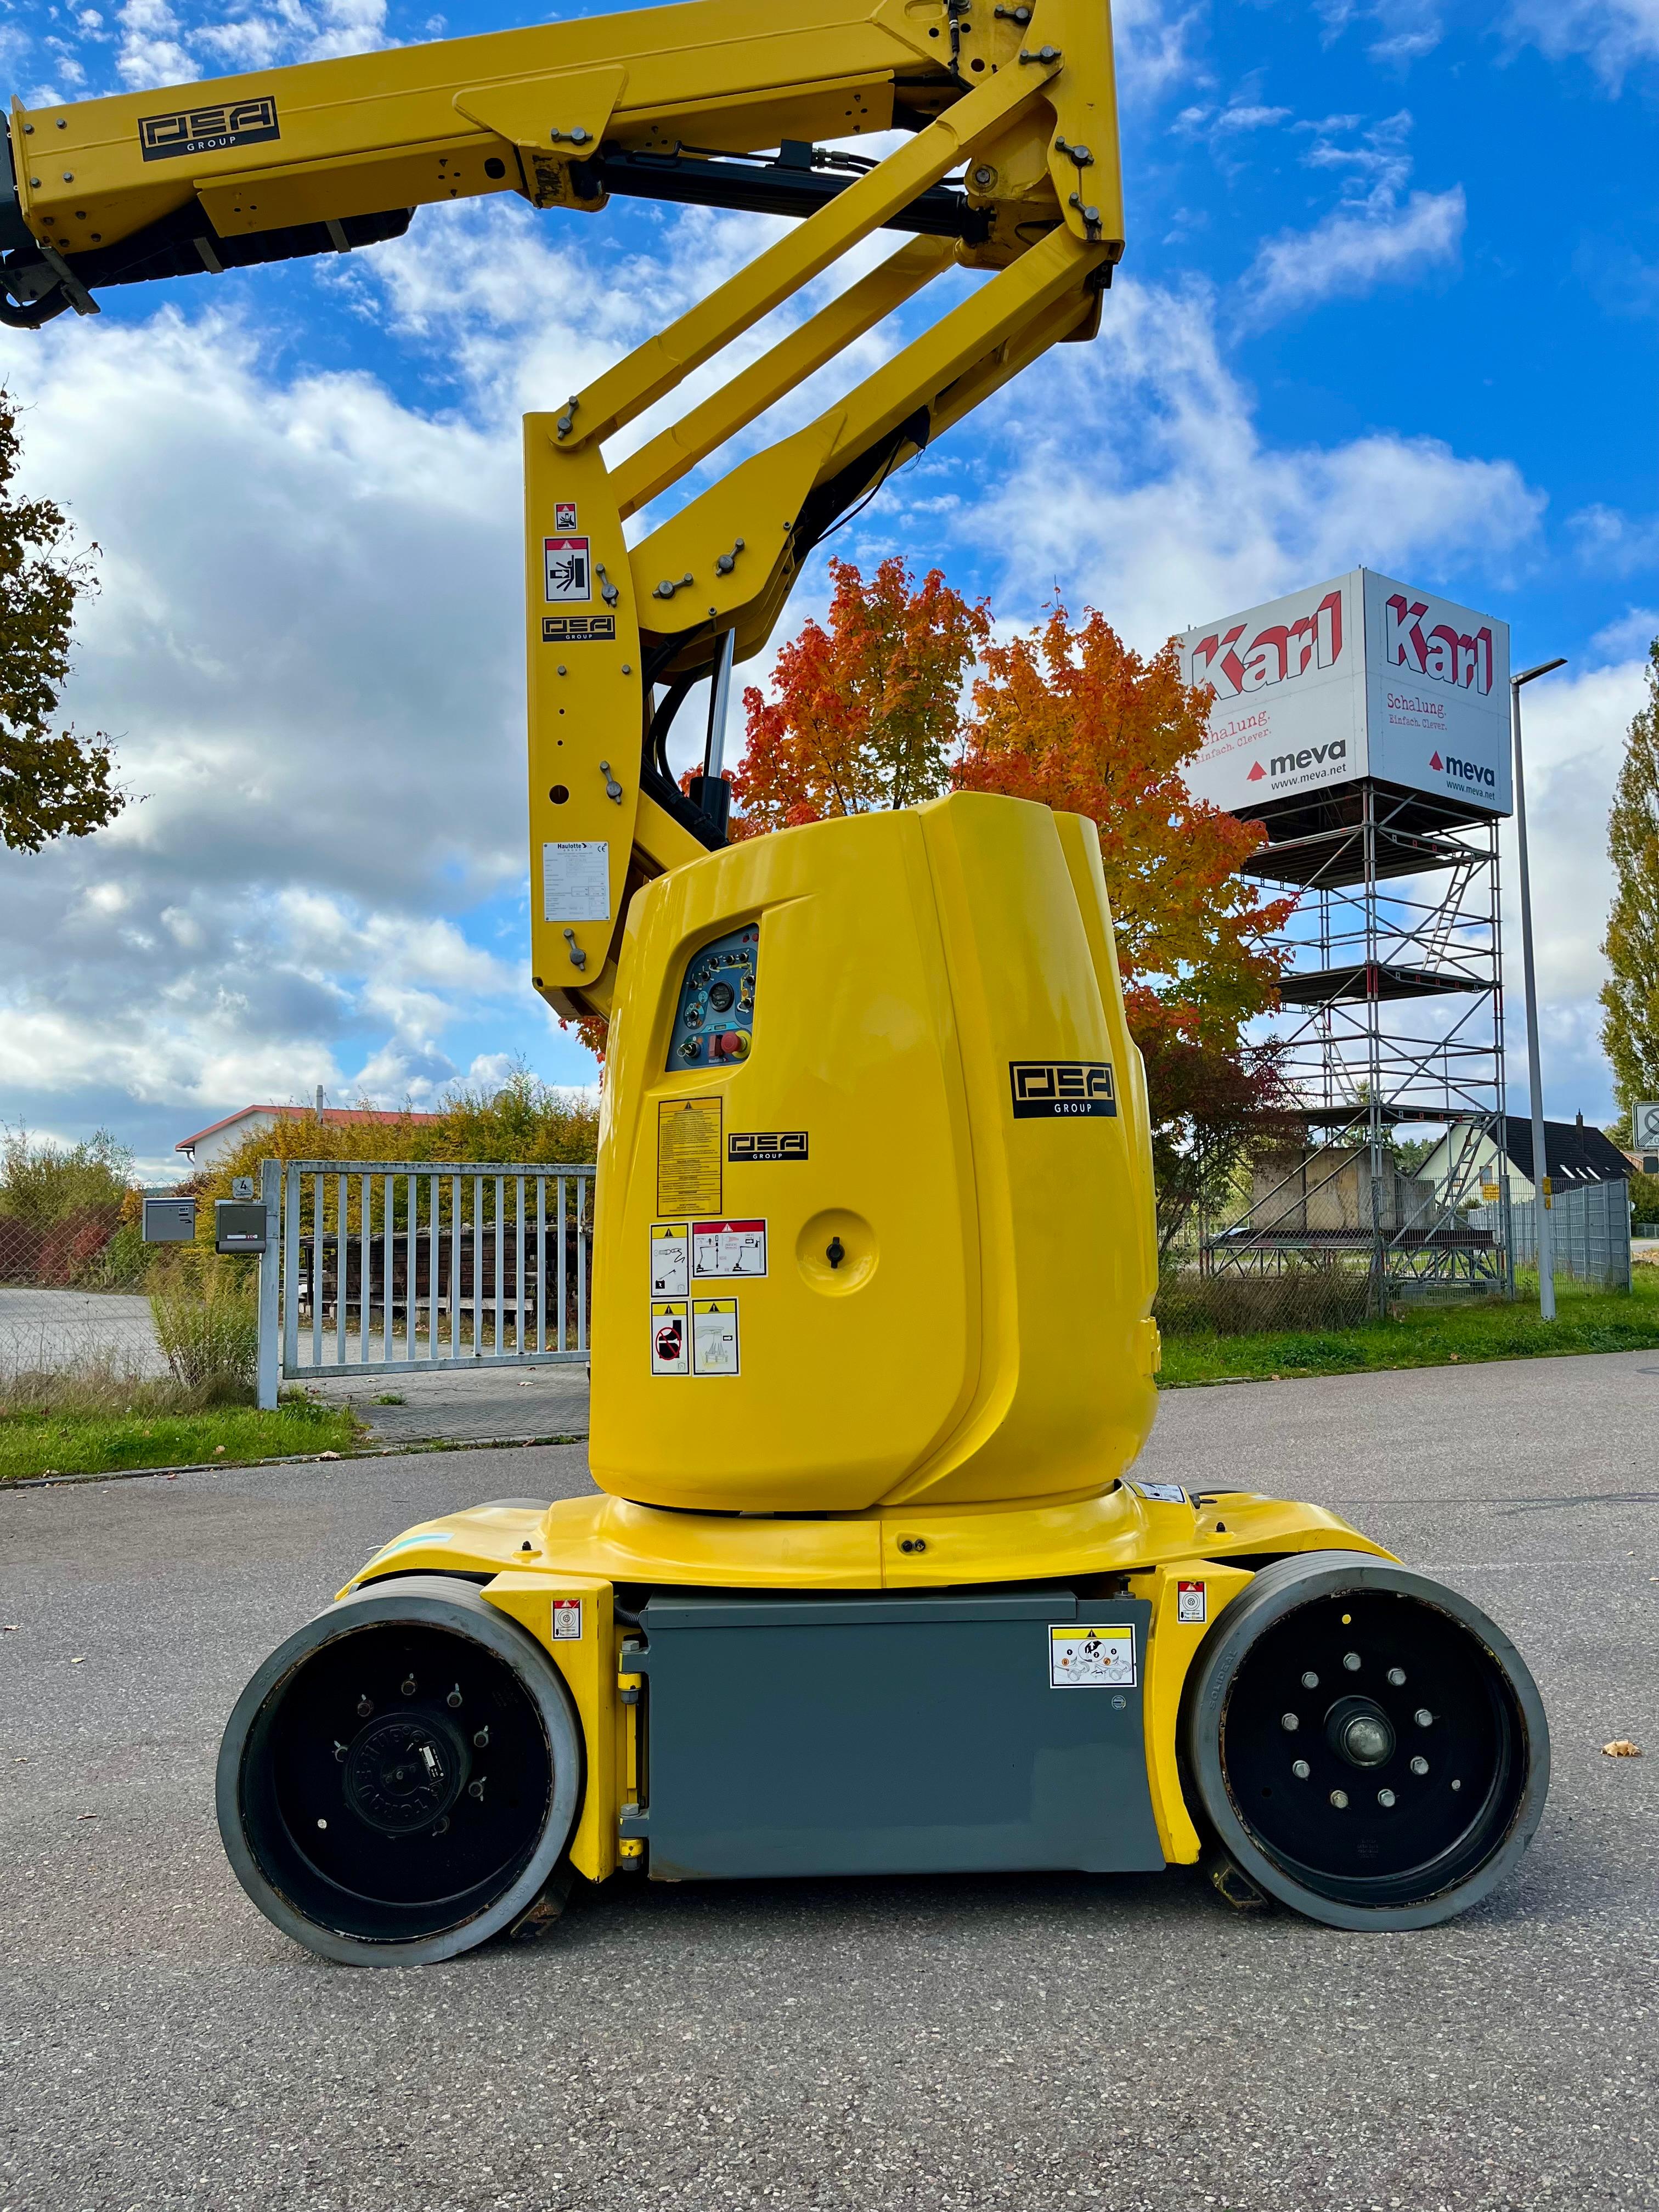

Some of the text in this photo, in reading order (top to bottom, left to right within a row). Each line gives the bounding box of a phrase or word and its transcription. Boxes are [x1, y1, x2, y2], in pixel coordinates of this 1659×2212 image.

[187, 136, 236, 151] GROUP
[1192, 590, 1342, 700] Karl
[1386, 594, 1492, 696] Karl
[1387, 693, 1446, 718] Schalung.
[1201, 710, 1271, 747] chalung.
[1389, 714, 1447, 730] Einfach. Clever.
[1237, 729, 1271, 747] Clever.
[1271, 740, 1346, 776] meva
[1271, 764, 1346, 790] www.meva.net
[1446, 756, 1494, 787] meva
[1446, 780, 1495, 800] www.meva.net
[1054, 1103, 1092, 1113] GROUP
[240, 1180, 247, 1190] 4
[1209, 1650, 1238, 1710] SOLIDEAL
